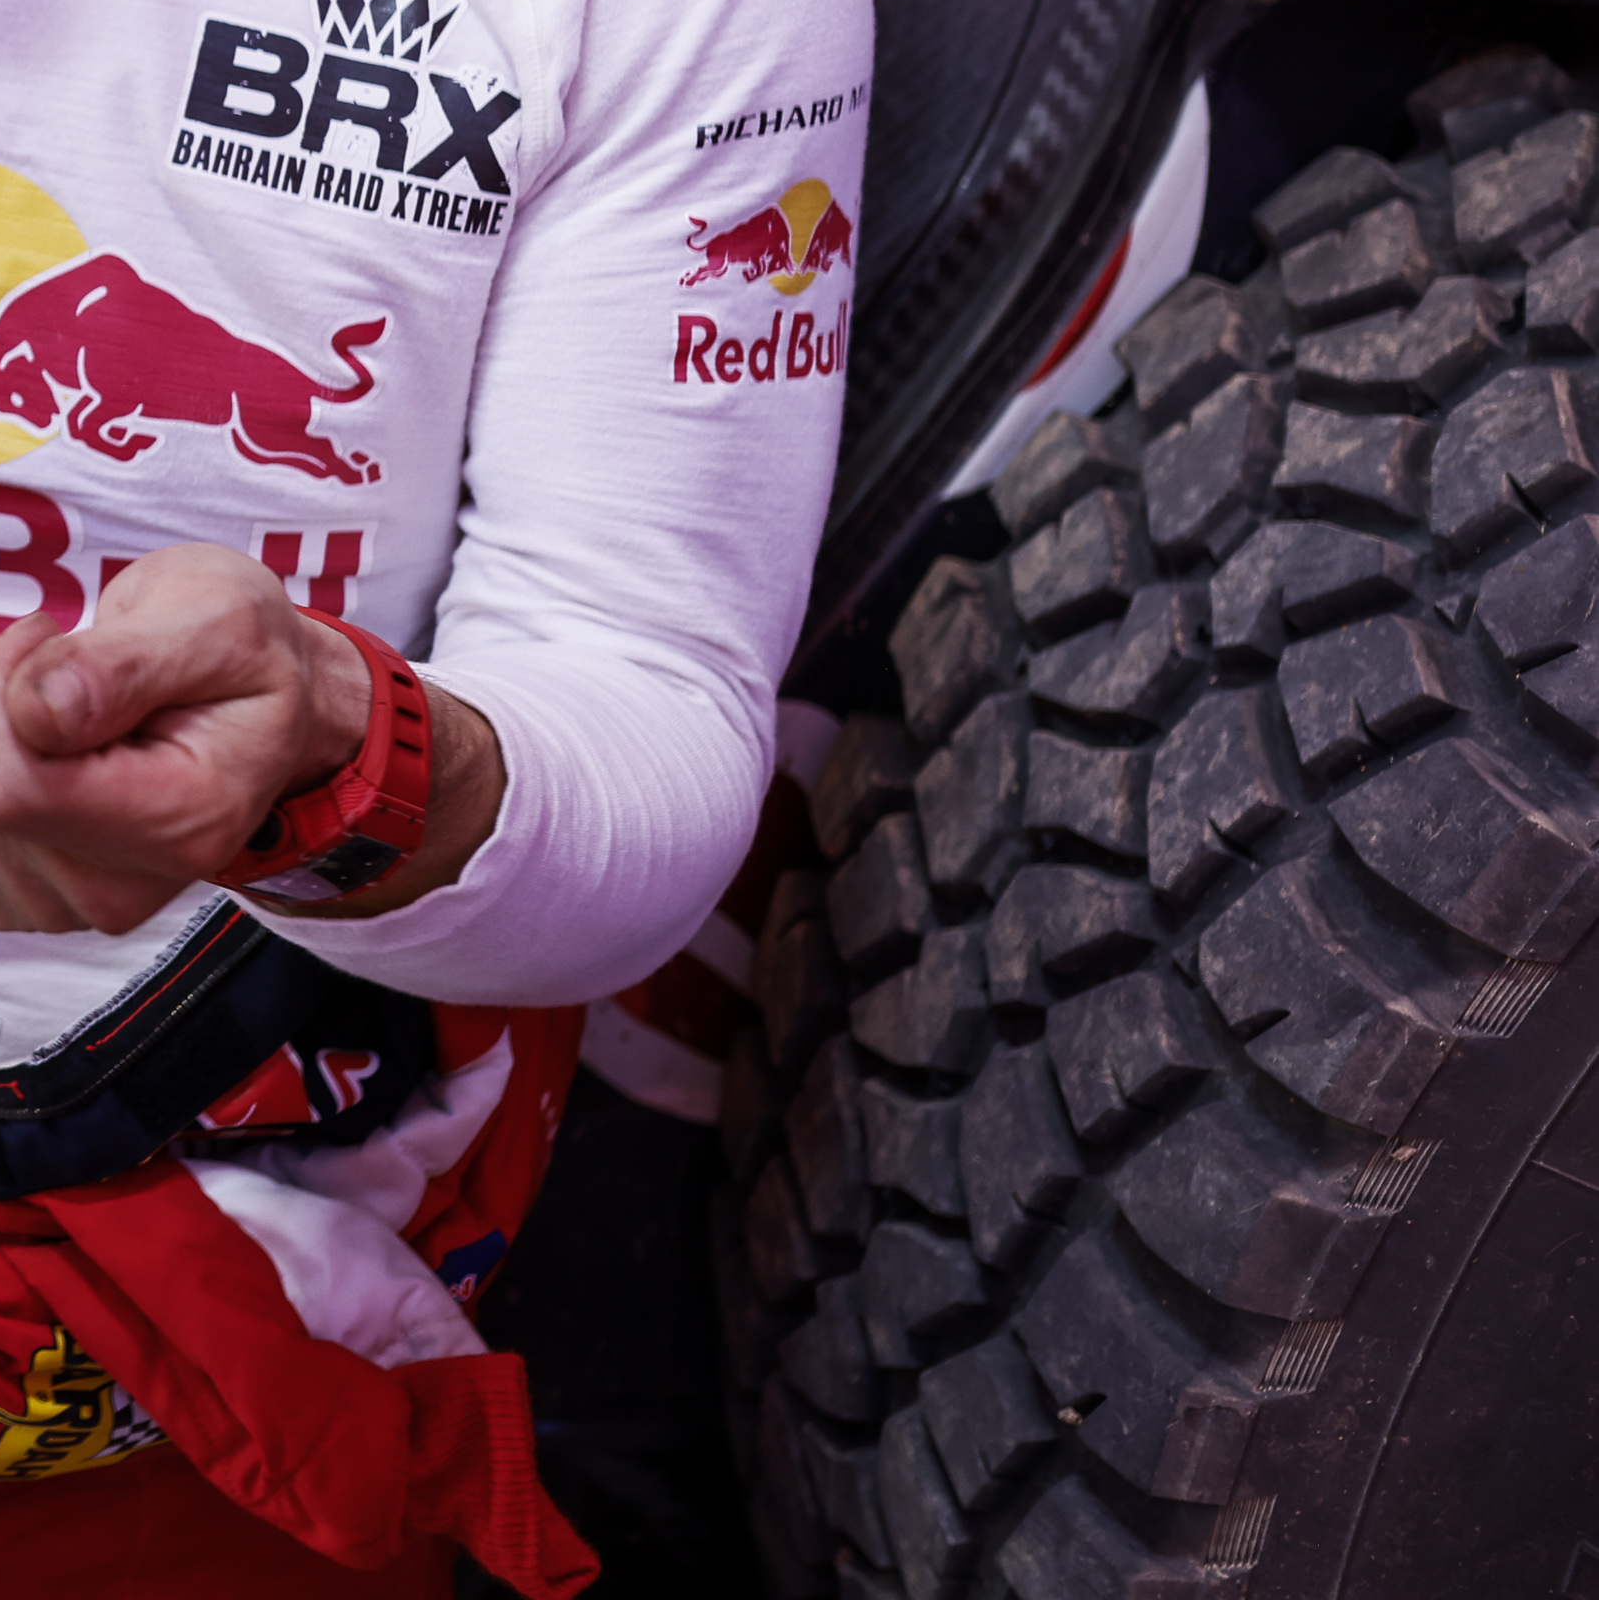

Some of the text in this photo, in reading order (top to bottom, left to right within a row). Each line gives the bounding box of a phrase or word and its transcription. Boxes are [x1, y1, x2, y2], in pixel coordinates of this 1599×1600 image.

[184, 19, 522, 196] BRX
[695, 94, 844, 150] RICHARD
[172, 129, 508, 236] BAHRAIN RAID XTREME
[674, 299, 850, 385] Red Bull
